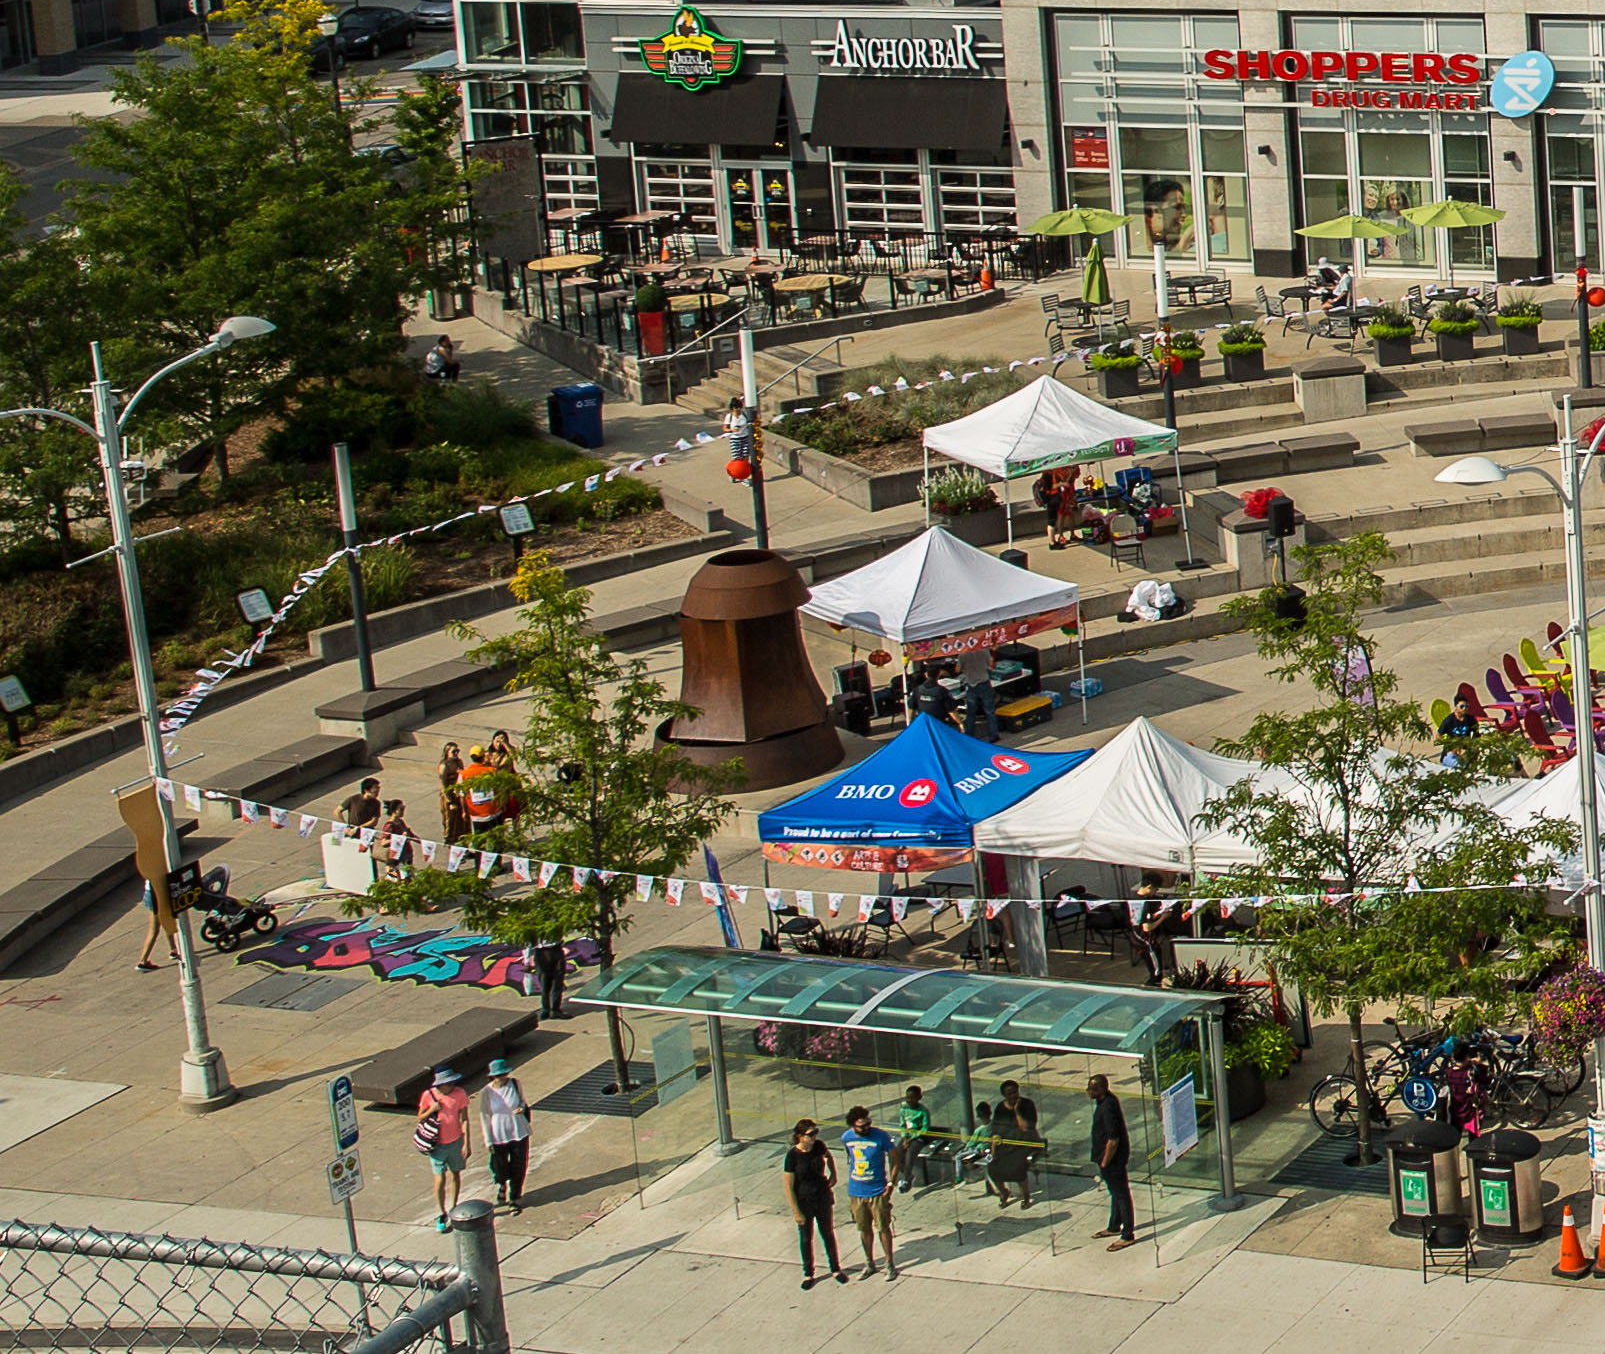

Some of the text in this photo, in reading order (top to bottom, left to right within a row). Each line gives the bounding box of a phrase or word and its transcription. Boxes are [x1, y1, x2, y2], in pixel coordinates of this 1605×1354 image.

[1202, 49, 1482, 86] SHOPPERS
[1311, 89, 1482, 112] DRUG MART
[953, 766, 1001, 795] BMO
[834, 784, 895, 799] BMO
[783, 826, 810, 838] Proud
[810, 828, 820, 838] to
[822, 827, 832, 838] be
[860, 828, 873, 838] of
[850, 860, 885, 871] CULTURE
[853, 850, 871, 862] ARTS
[172, 886, 202, 913] LOOP
